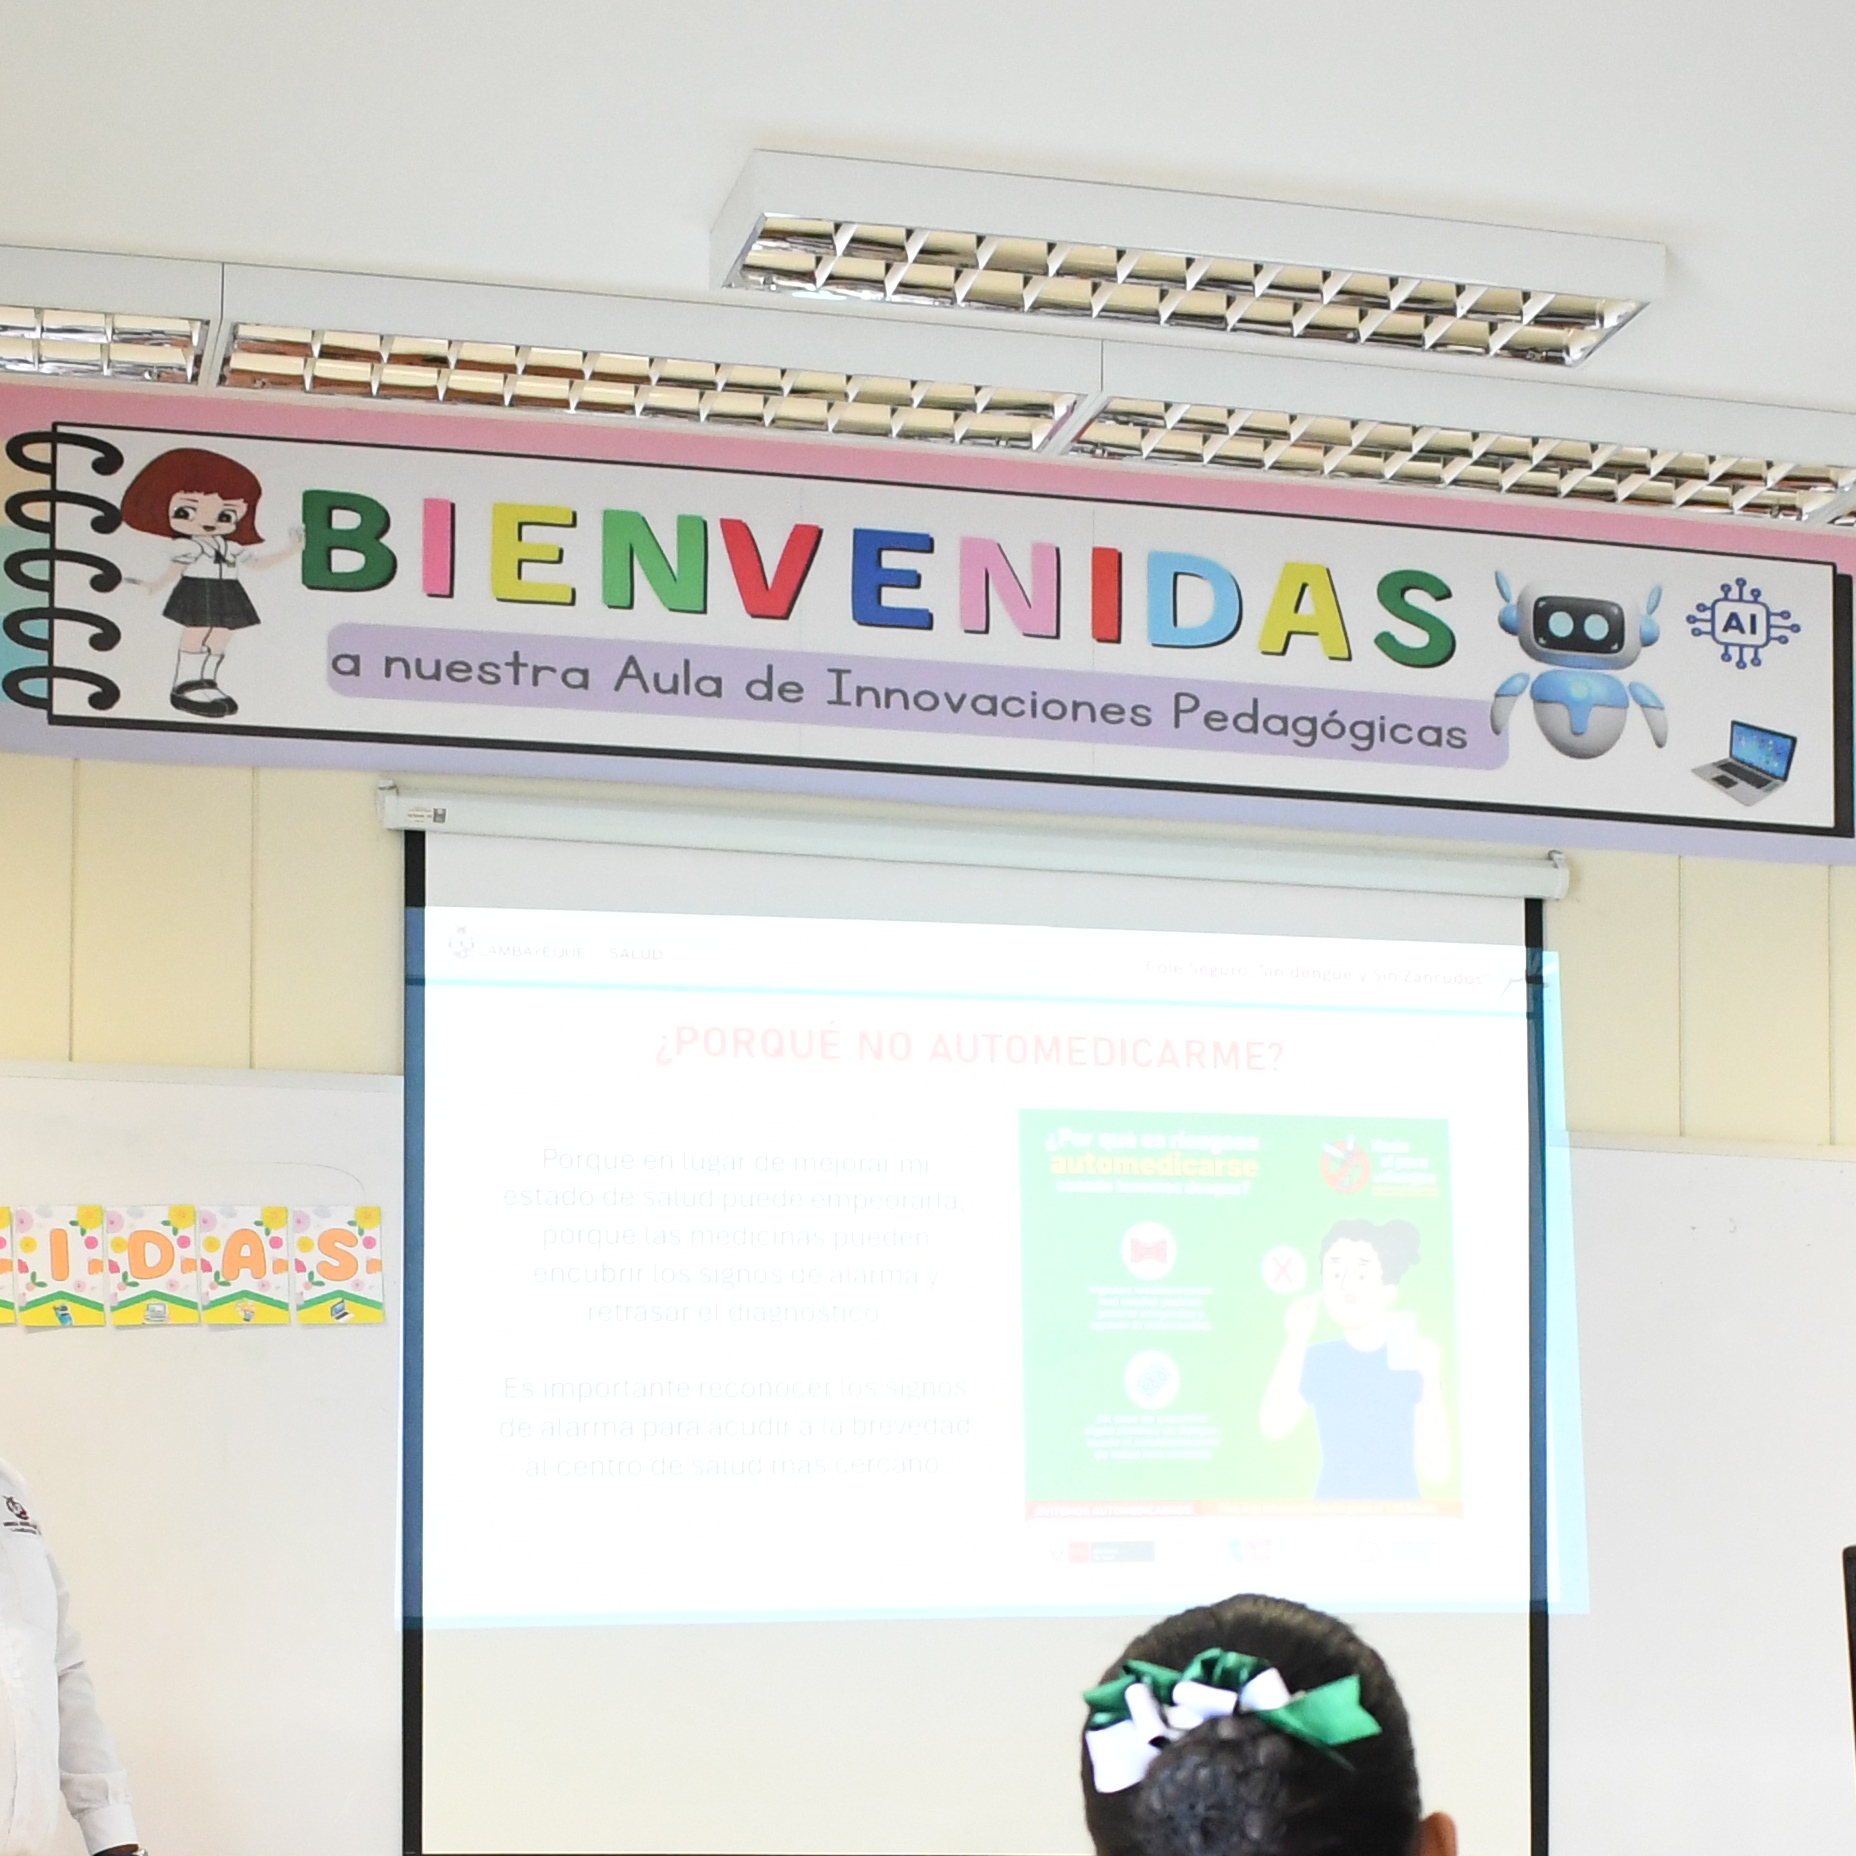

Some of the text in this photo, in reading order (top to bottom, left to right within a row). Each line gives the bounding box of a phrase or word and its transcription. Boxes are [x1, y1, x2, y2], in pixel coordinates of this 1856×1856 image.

[299, 487, 1457, 670] BIENVENIDAS
[1721, 611, 1758, 636] AI
[332, 646, 1468, 753] a nuestra Aula de Innovaciones Pedagógicas
[609, 947, 663, 961] SALUD
[655, 1020, 1284, 1073] ¿PORQUÉ NO AUTOMEDICARME?
[543, 1147, 635, 1174] Porque
[643, 1154, 674, 1170] en
[682, 1150, 745, 1178] lugar
[754, 1152, 785, 1172] de
[1050, 1152, 1260, 1178] automedicarse
[503, 1187, 594, 1209] estado
[602, 1188, 635, 1208] de
[643, 1188, 714, 1209] salud
[722, 1189, 803, 1214] puede
[543, 1226, 929, 1252] porque las medicinas pueden
[533, 1263, 645, 1285] encubrir
[653, 1264, 691, 1285] los
[699, 1265, 783, 1290] signos
[790, 1265, 822, 1285] de
[829, 1265, 919, 1286] alarma
[587, 1302, 690, 1324] retrasar
[504, 1376, 534, 1399] Es
[544, 1376, 691, 1403] importante
[699, 1377, 833, 1399] reconocer
[885, 1377, 968, 1403] signos
[499, 1416, 531, 1437] de
[541, 1416, 635, 1438] alarma
[643, 1419, 700, 1442] para
[852, 1415, 971, 1436] brevedad
[556, 1457, 643, 1478] centro
[651, 1455, 683, 1476] de
[691, 1455, 762, 1477] salud
